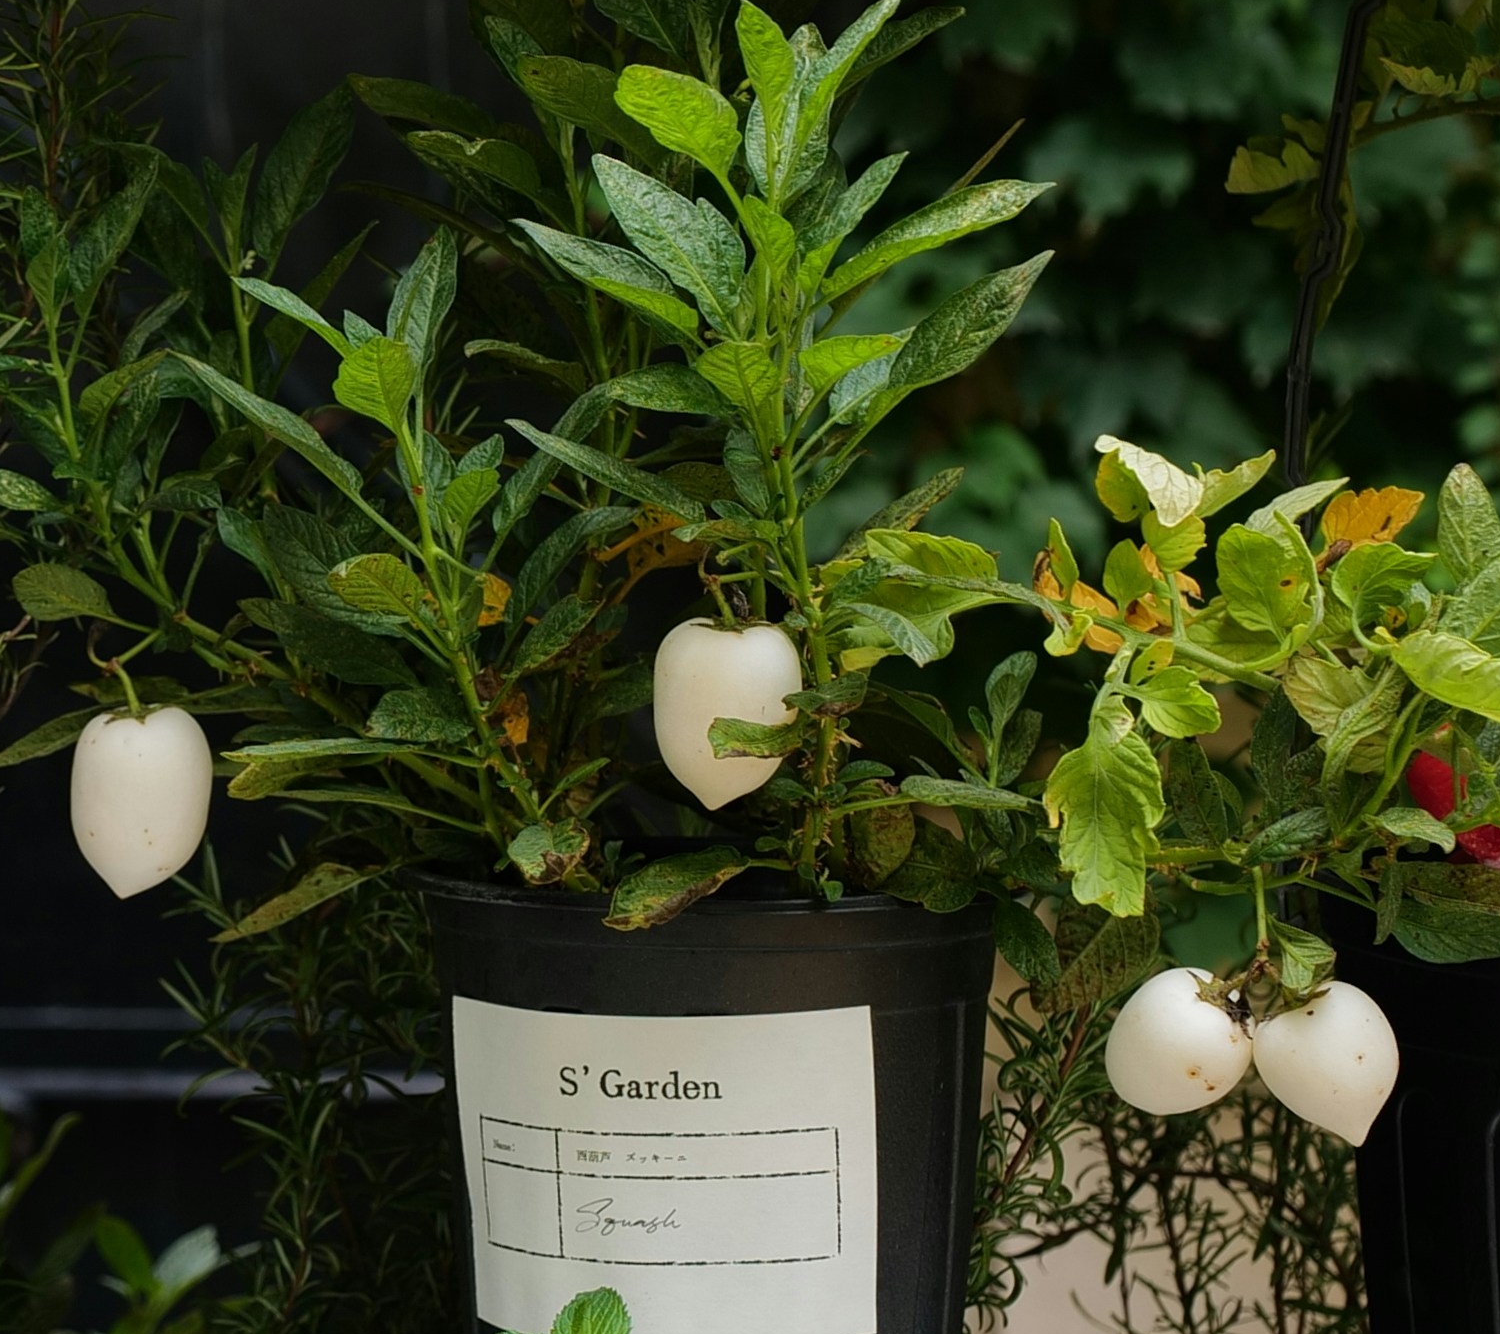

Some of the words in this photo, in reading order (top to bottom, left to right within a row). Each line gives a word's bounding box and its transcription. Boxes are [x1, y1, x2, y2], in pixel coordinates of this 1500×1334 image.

[559, 1064, 590, 1097] S'
[599, 1068, 723, 1101] Garden
[574, 1197, 681, 1237] Squash
